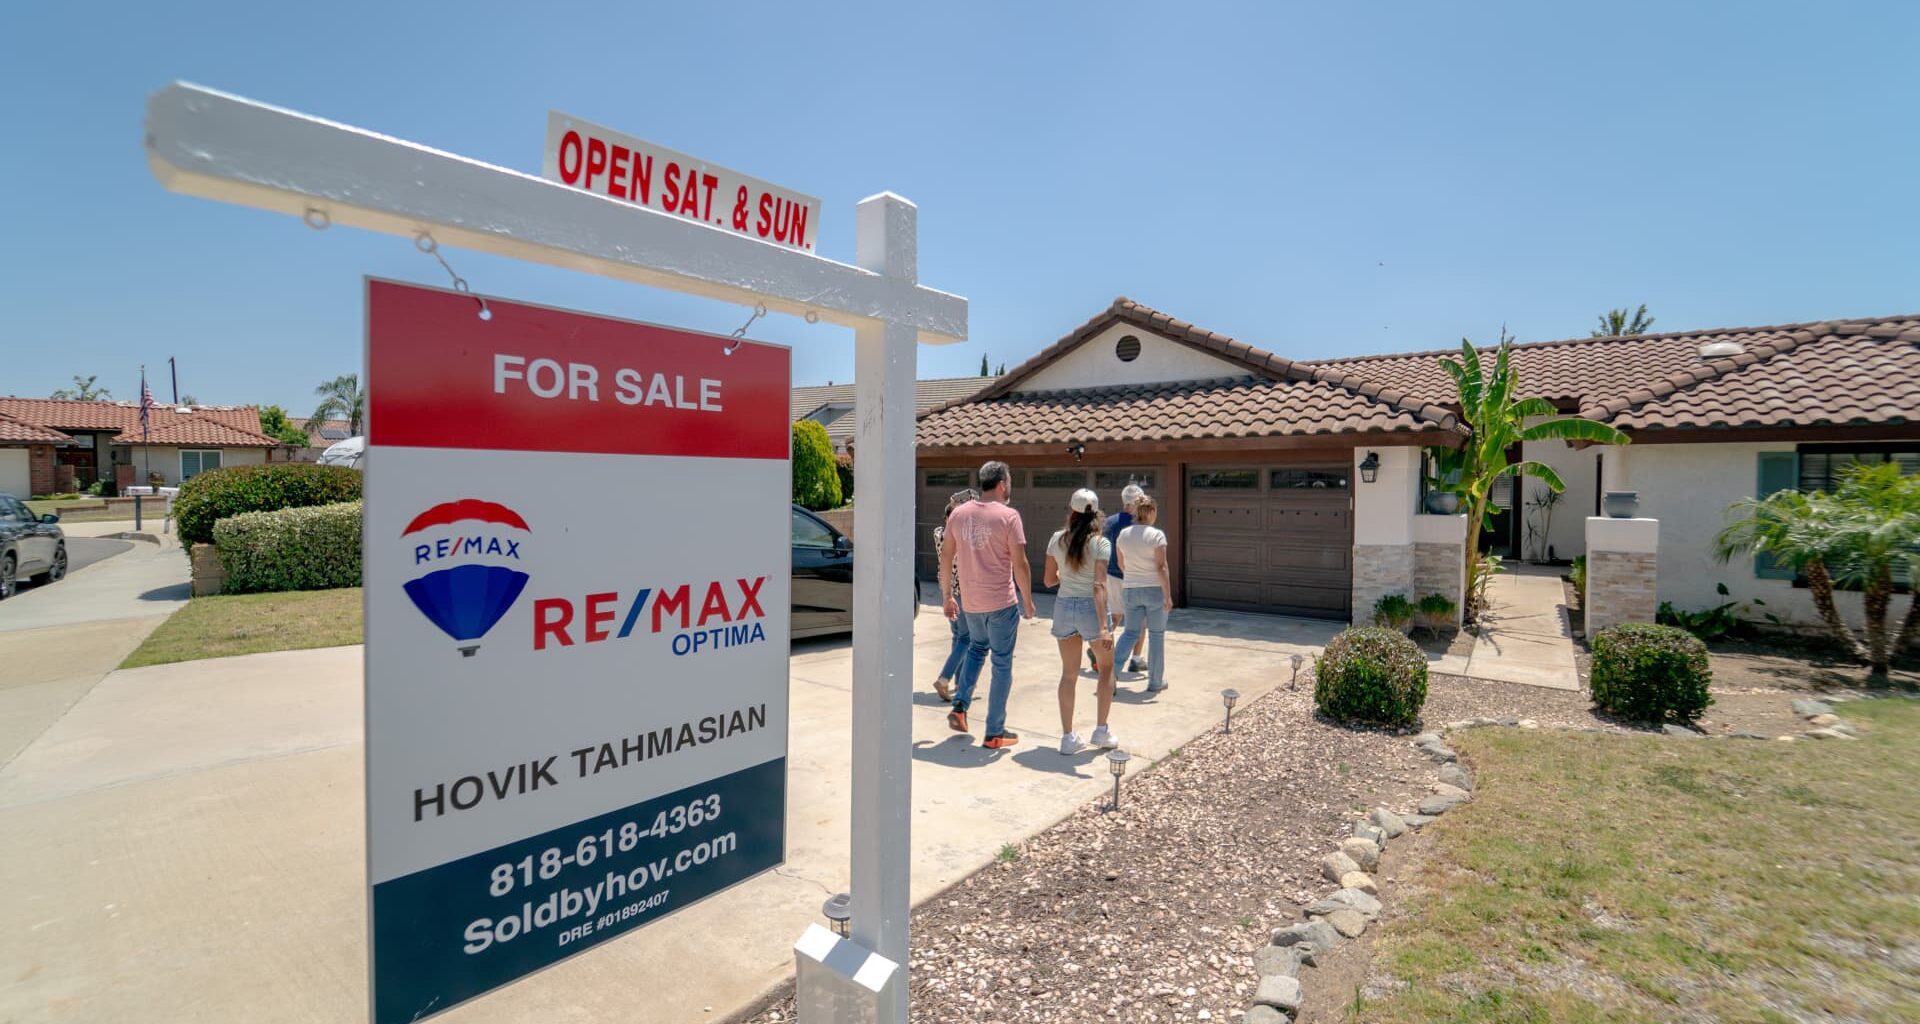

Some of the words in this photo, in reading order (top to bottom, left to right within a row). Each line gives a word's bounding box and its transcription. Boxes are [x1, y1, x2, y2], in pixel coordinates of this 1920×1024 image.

[558, 130, 653, 205] OPEN
[661, 162, 722, 225] SAT.
[732, 185, 749, 232] &
[756, 192, 811, 249] SUN.
[494, 353, 599, 402] FOR
[614, 368, 723, 412] SALE
[415, 536, 520, 565] RE/MAX
[533, 576, 765, 650] RE/MAX
[671, 622, 766, 656] OPTIMA
[413, 755, 558, 822] HOVIK
[571, 704, 767, 778] TAHMASIAN
[489, 793, 721, 897] 818-618-4363
[463, 830, 737, 955] Soldbyhov.com
[558, 920, 593, 947] DRE
[596, 890, 670, 931] #01892407
